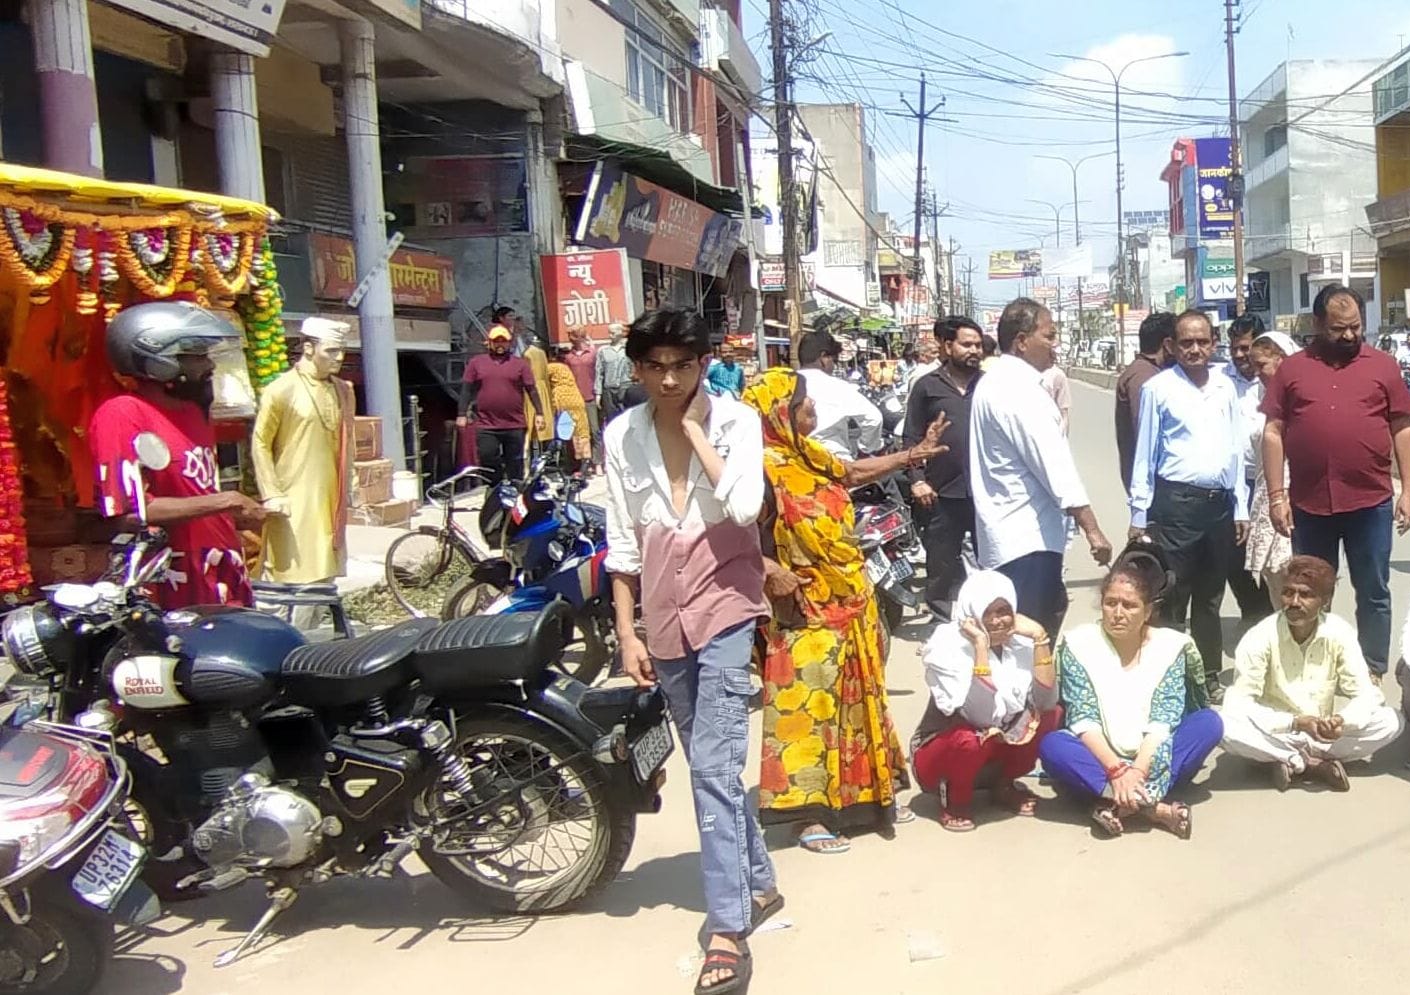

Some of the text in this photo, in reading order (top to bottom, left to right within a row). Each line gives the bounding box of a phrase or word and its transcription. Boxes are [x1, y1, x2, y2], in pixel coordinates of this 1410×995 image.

[567, 264, 597, 286] न्यू
[560, 290, 610, 326] जोशी
[125, 677, 157, 686] ROYAL
[124, 686, 164, 696] ENFIELD
